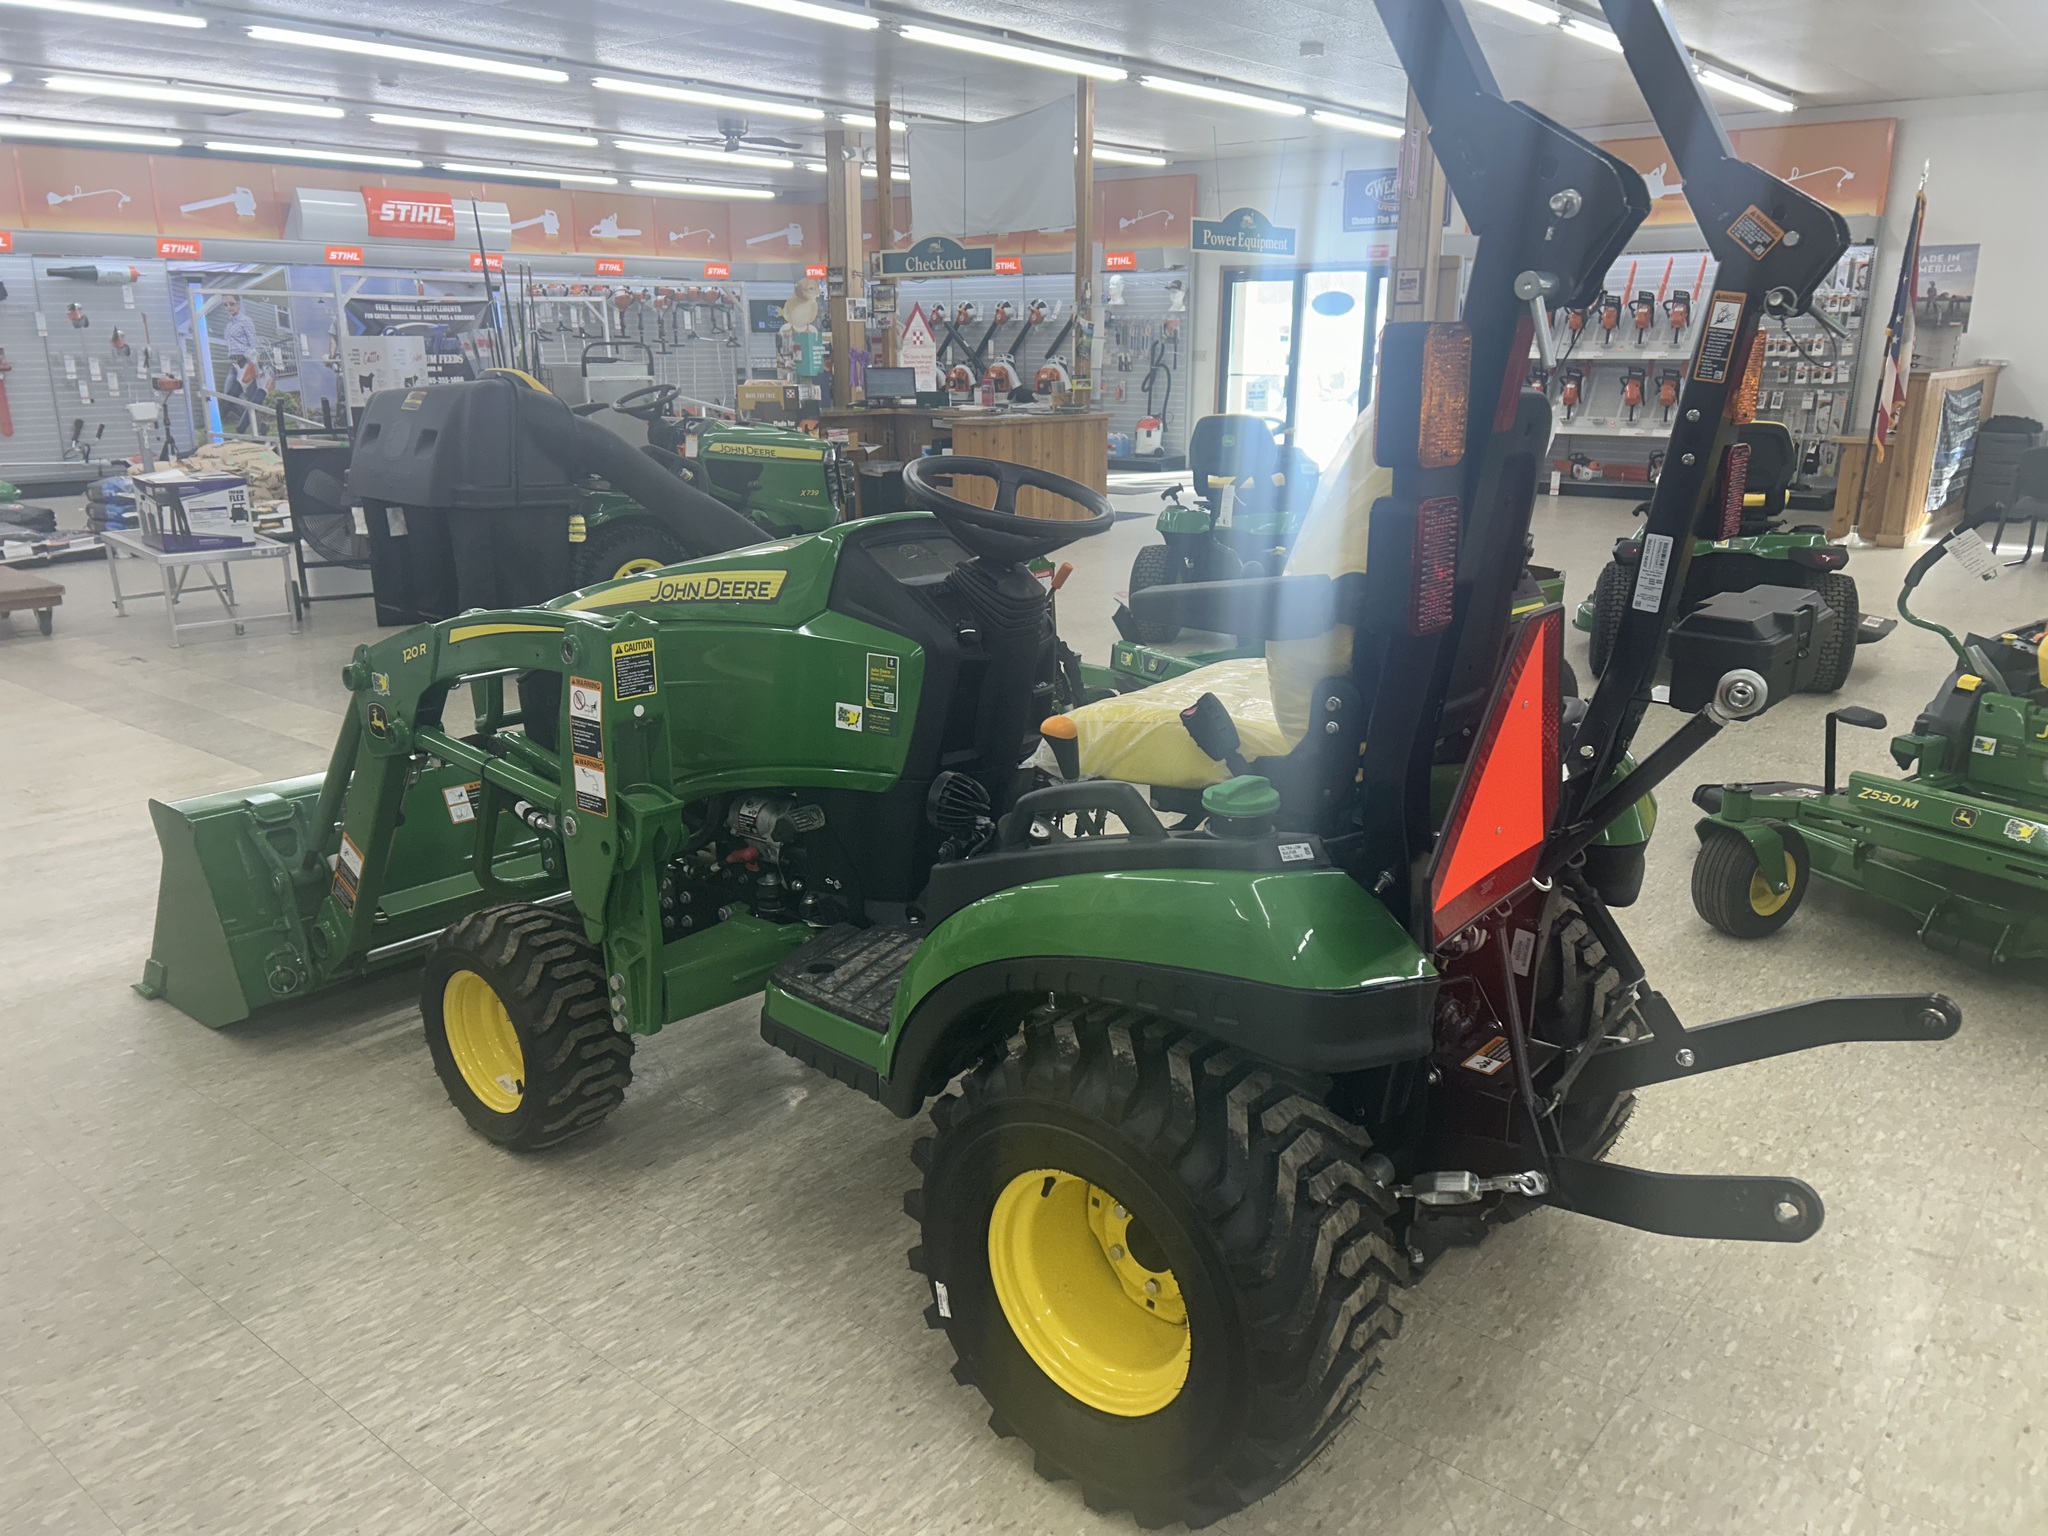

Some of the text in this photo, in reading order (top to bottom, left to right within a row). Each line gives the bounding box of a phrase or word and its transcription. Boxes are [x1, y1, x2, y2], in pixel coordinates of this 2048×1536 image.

[1365, 177, 1399, 198] WEA
[1377, 203, 1400, 212] LIVEST
[380, 203, 447, 224] STIHL
[1351, 216, 1375, 225] Choose
[1377, 215, 1389, 224] The
[1755, 213, 1780, 238] WARNING
[1203, 229, 1288, 252] Power Equipment
[161, 243, 197, 254] STIHL
[329, 251, 360, 261] STIHL
[1107, 257, 1132, 266] STIHL
[1919, 253, 1960, 264] ADE IN
[473, 257, 500, 267] SIHL
[598, 262, 622, 271] STIHL
[905, 255, 967, 272] Checkout
[995, 262, 1017, 270] STIHL
[707, 266, 729, 276] STIHL
[806, 268, 825, 276] STIHL
[1919, 264, 1962, 274] MERICA
[375, 303, 390, 312] FEED,
[391, 304, 416, 312] MINERAL
[422, 305, 462, 313] SUPPLEMENTS
[438, 354, 464, 364] FEEDS
[719, 444, 776, 457] JOHN DEERE
[800, 489, 820, 497] X739
[650, 578, 771, 599] JOHN DEERE
[624, 640, 652, 653] CAUTION
[402, 643, 427, 663] 120 R
[576, 678, 600, 690] WARNING
[578, 758, 604, 771] WARNING
[1857, 787, 1920, 809] Z530 M
